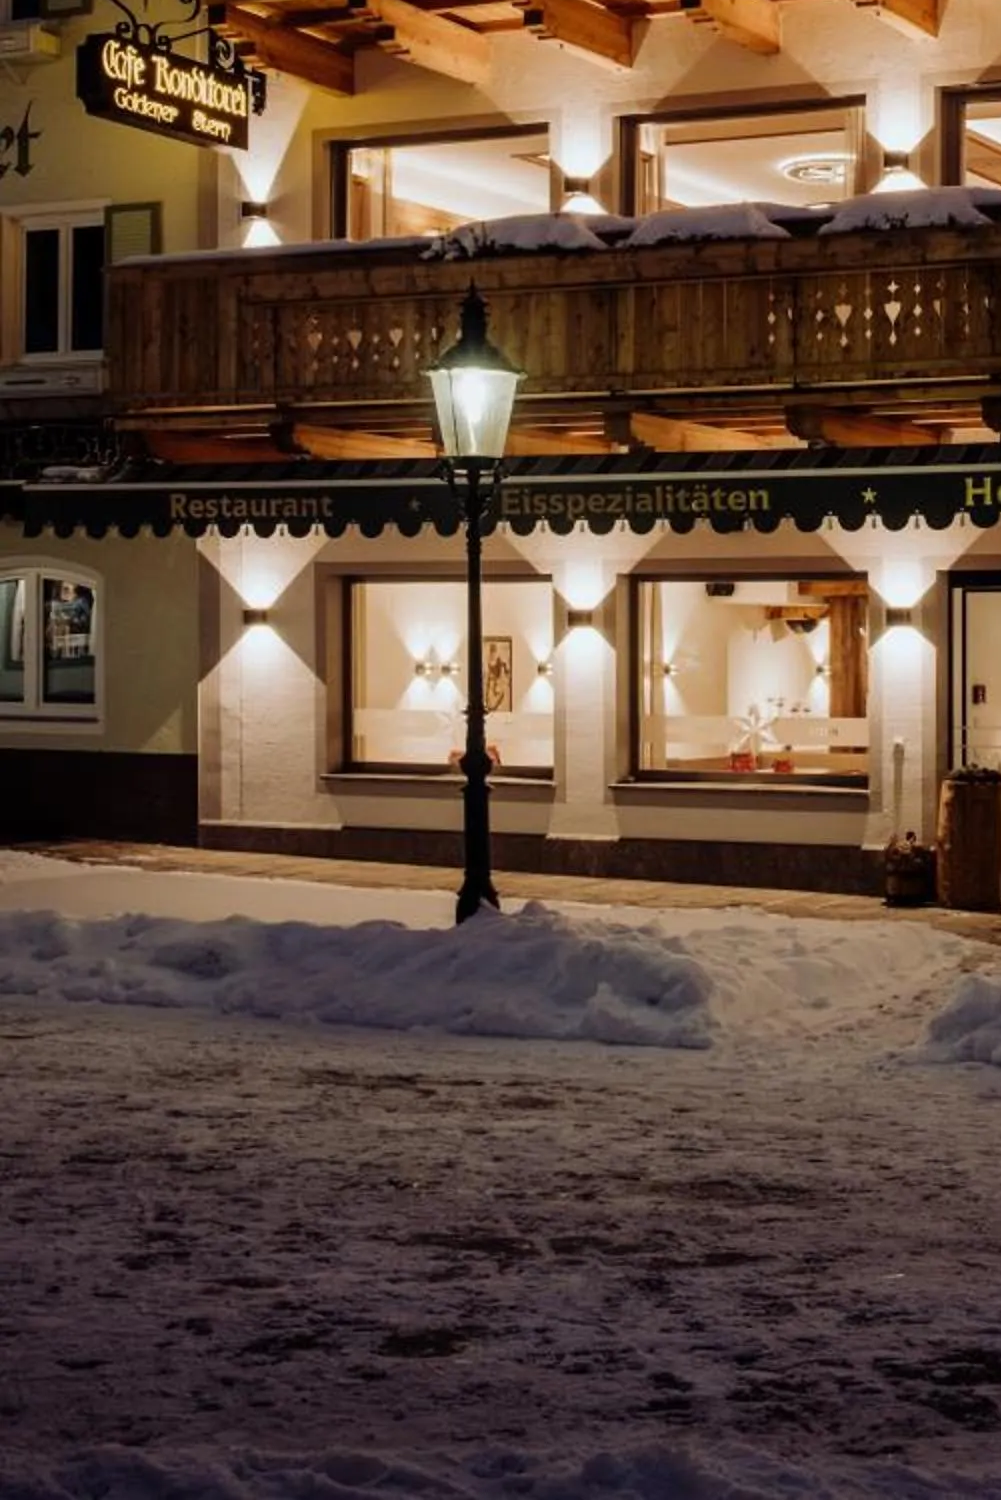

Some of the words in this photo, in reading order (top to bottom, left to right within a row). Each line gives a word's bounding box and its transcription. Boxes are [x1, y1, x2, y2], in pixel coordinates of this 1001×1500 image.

[151, 55, 247, 117] Konditorei
[114, 88, 180, 124] Goldener
[192, 110, 231, 142] Stern
[170, 492, 334, 519] Restaurant
[501, 485, 770, 520] Eisspezialitäten
